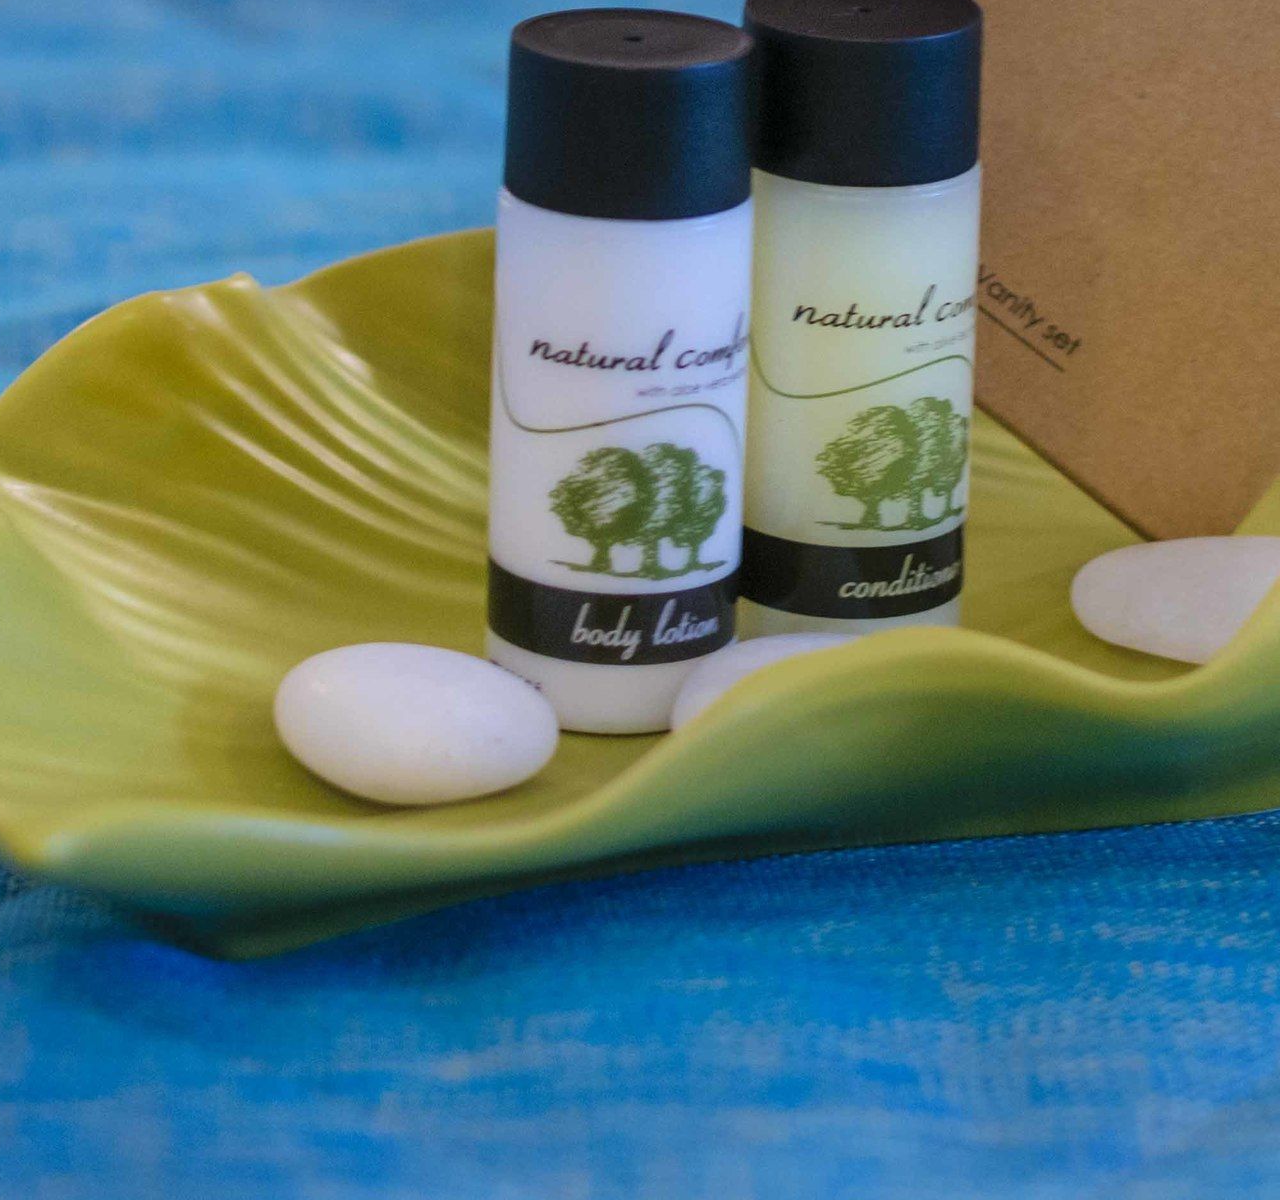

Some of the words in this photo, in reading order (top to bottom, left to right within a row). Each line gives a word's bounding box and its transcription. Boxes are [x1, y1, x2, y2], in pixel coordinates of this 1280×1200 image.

[792, 283, 937, 329] natural
[528, 328, 676, 371] natural
[1040, 324, 1083, 356] set
[572, 602, 643, 661] body
[651, 598, 720, 646] lotion
